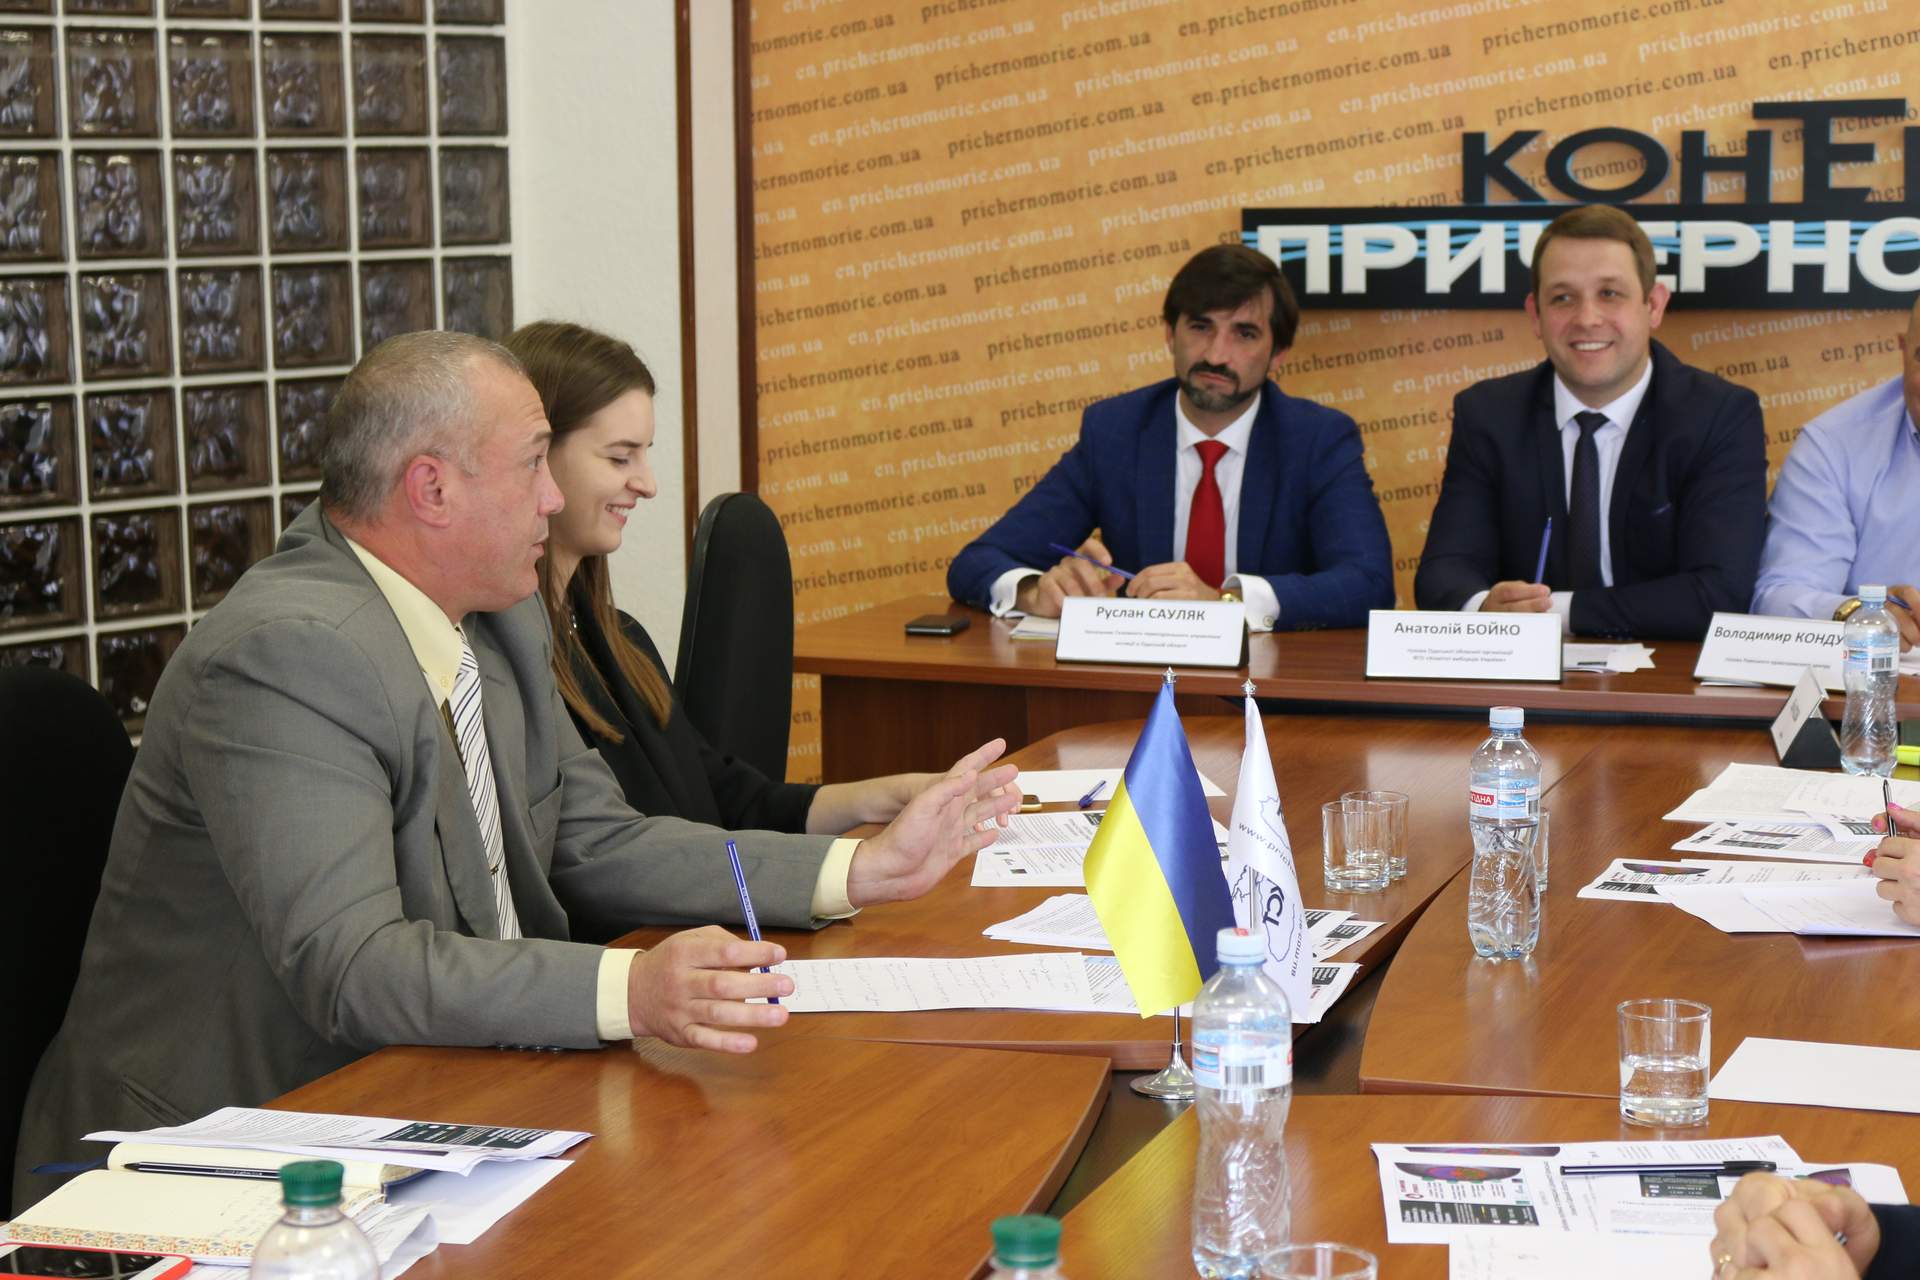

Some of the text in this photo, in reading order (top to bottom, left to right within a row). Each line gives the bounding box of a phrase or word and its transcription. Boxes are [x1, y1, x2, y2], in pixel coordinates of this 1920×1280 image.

[795, 20, 1036, 81] en.prichernomorie.com.ua
[934, 30, 1152, 91] prichernomorie.com.ua
[947, 99, 1165, 159] prichernomorie.com.ua
[1192, 44, 1452, 106] en.prichernomorie.com.ua
[1482, 0, 1724, 54] prichernomorie.com.ua
[808, 88, 1049, 148] en.prichernomorie.com.ua
[1075, 38, 1298, 97] prichernomorie.com.ua
[822, 0, 1888, 214] en.prichernomorie.com.ua prichernomorie.com.ua en.prichernomorie.com.ua prichernomorie.com.ua
[960, 168, 1178, 226] prichernomorie.com.ua
[1205, 115, 1465, 175] en.prichernomorie.com.ua
[1495, 63, 1737, 125] prichernomorie.com.ua
[1462, 98, 1920, 206] КОНТЕ
[835, 223, 1075, 280] en.prichernomorie.com.ua
[1101, 177, 1325, 236] prichernomorie.com.ua
[757, 282, 947, 328] ichernomorie.com.ua
[974, 237, 1191, 294] prichernomorie.com.ua
[848, 291, 1088, 347] en.prichernomorie.com.ua
[861, 359, 1100, 413] en.prichernomorie.com.ua
[1096, 606, 1206, 622] Руслан САУЛЯК
[1394, 621, 1521, 636] Анатолій БОЙКО
[1714, 626, 1792, 644] Володимир
